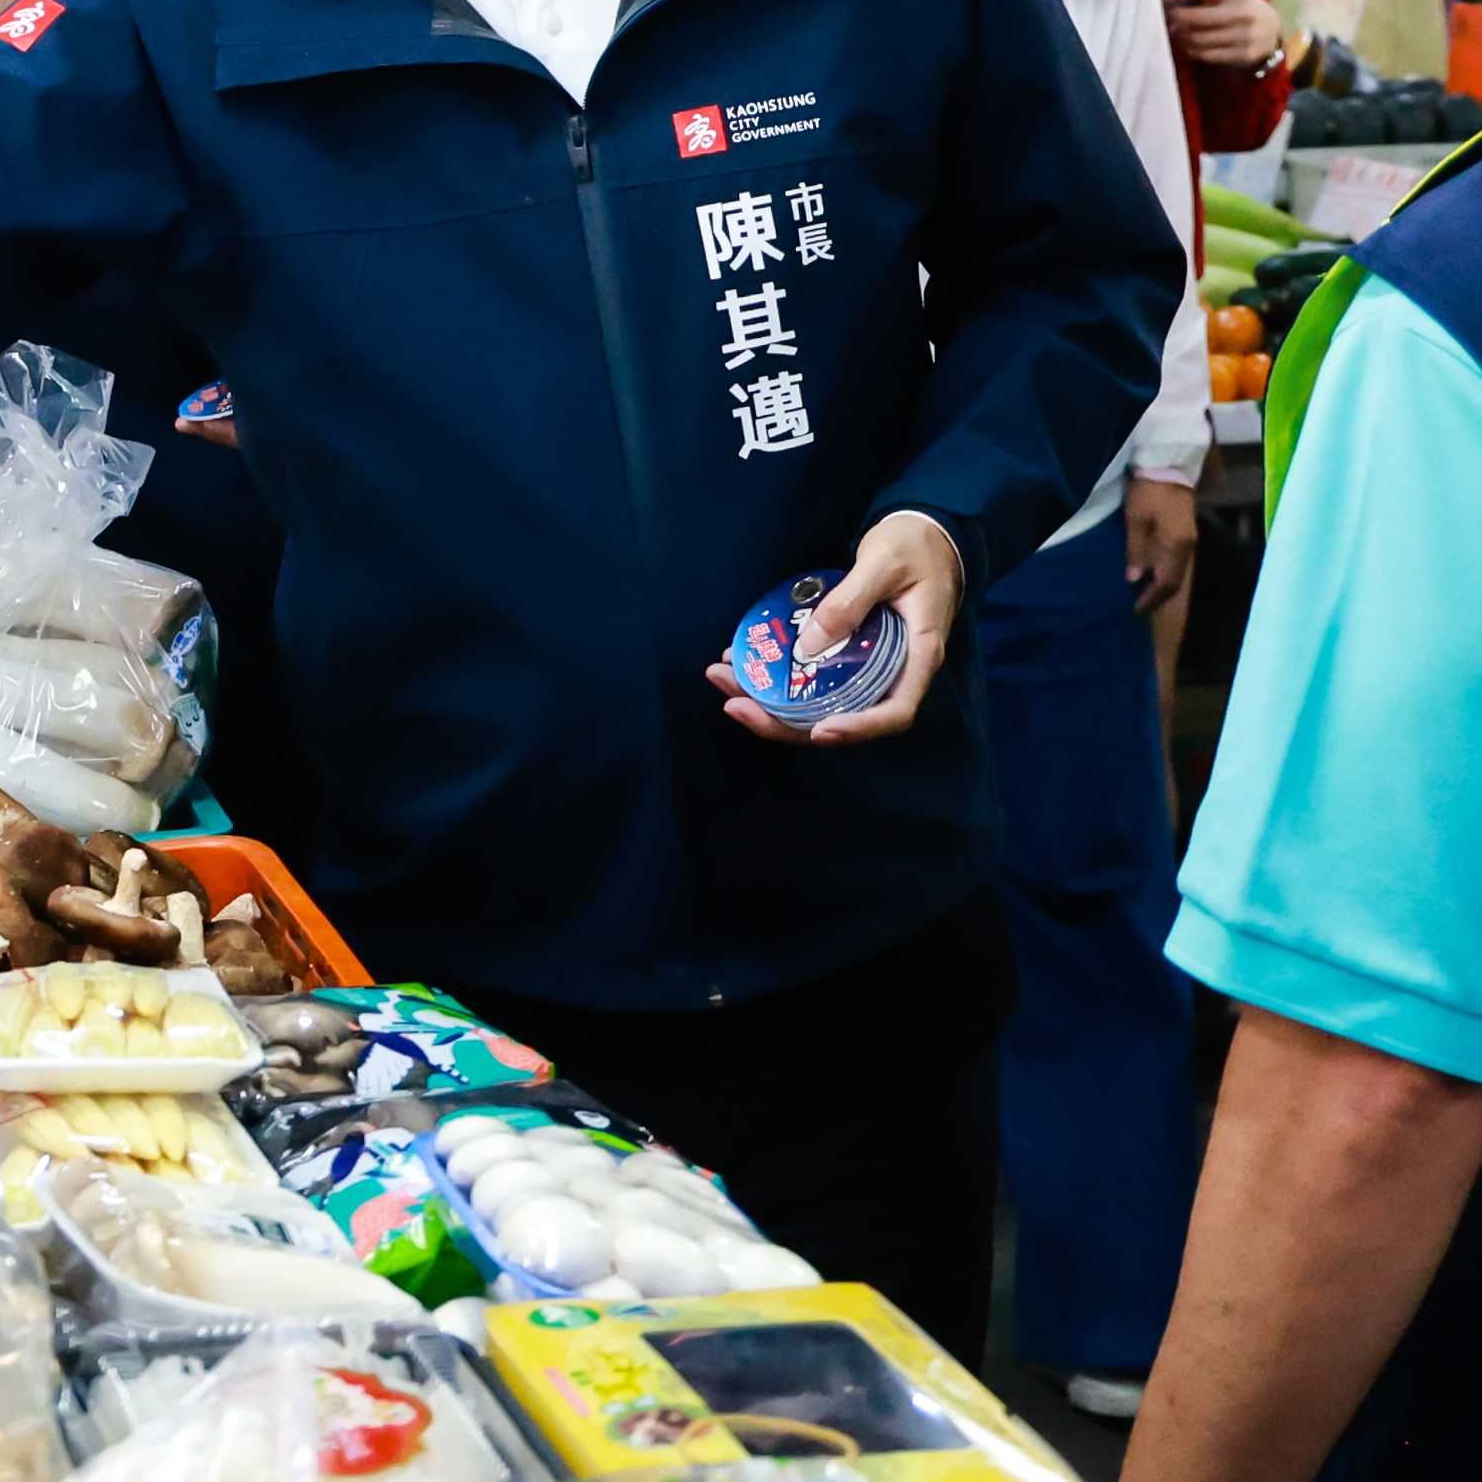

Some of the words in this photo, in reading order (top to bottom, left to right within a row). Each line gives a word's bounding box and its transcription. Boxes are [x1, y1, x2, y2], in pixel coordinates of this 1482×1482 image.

[726, 92, 817, 120] KAOHSIUNG
[729, 117, 760, 131] CITY
[731, 118, 821, 143] GOVERNMENT
[785, 181, 835, 266] 市長
[696, 191, 815, 460] 陳其邁
